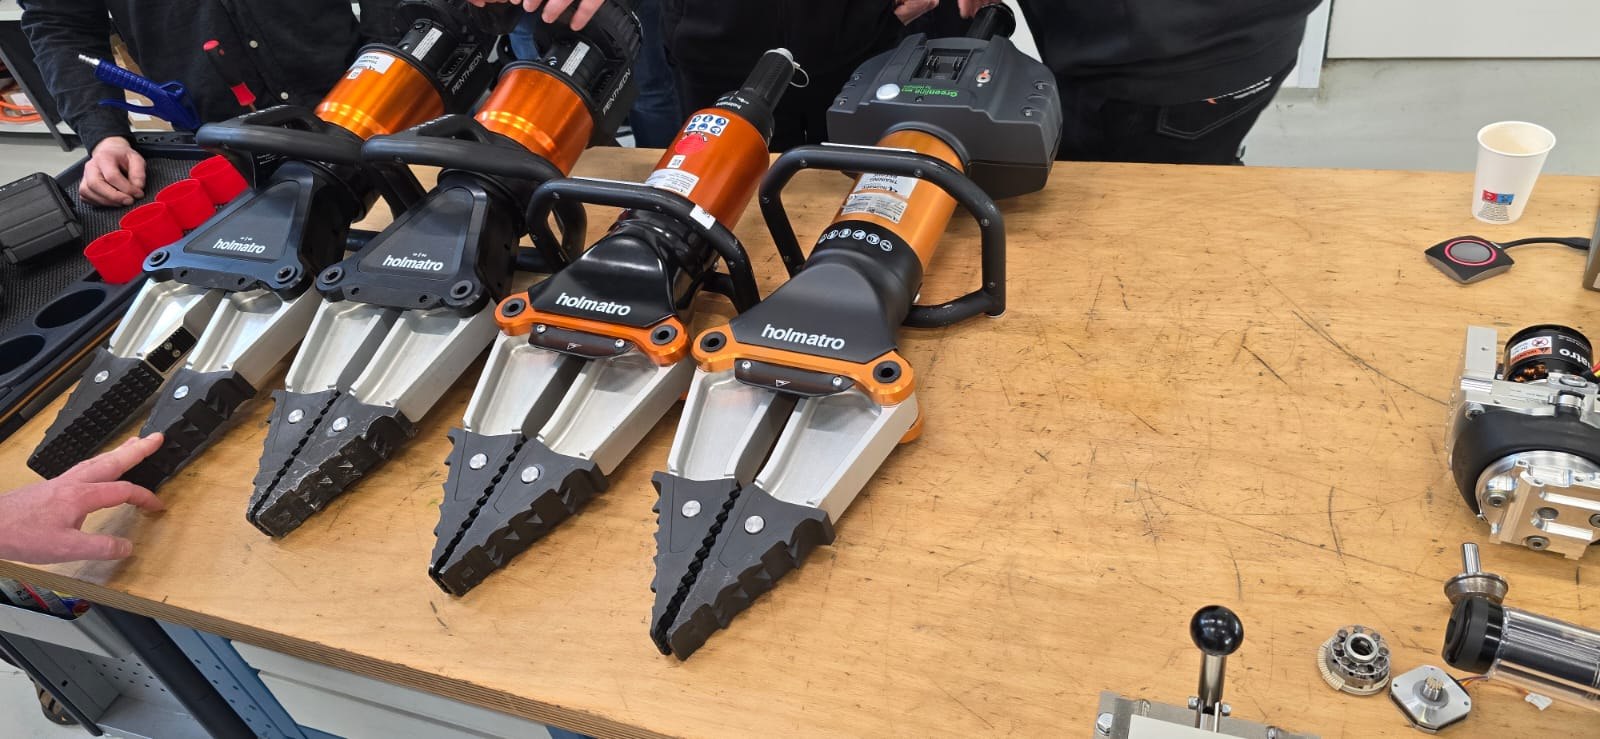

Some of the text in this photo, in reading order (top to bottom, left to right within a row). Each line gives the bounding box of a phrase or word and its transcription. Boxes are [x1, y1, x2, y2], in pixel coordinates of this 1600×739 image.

[451, 51, 483, 95] PENTHEON
[602, 67, 631, 116] PENTHEON
[212, 238, 266, 254] holmatro
[382, 254, 444, 271] holmatro
[555, 292, 631, 316] holmatro
[761, 323, 845, 350] holmatro
